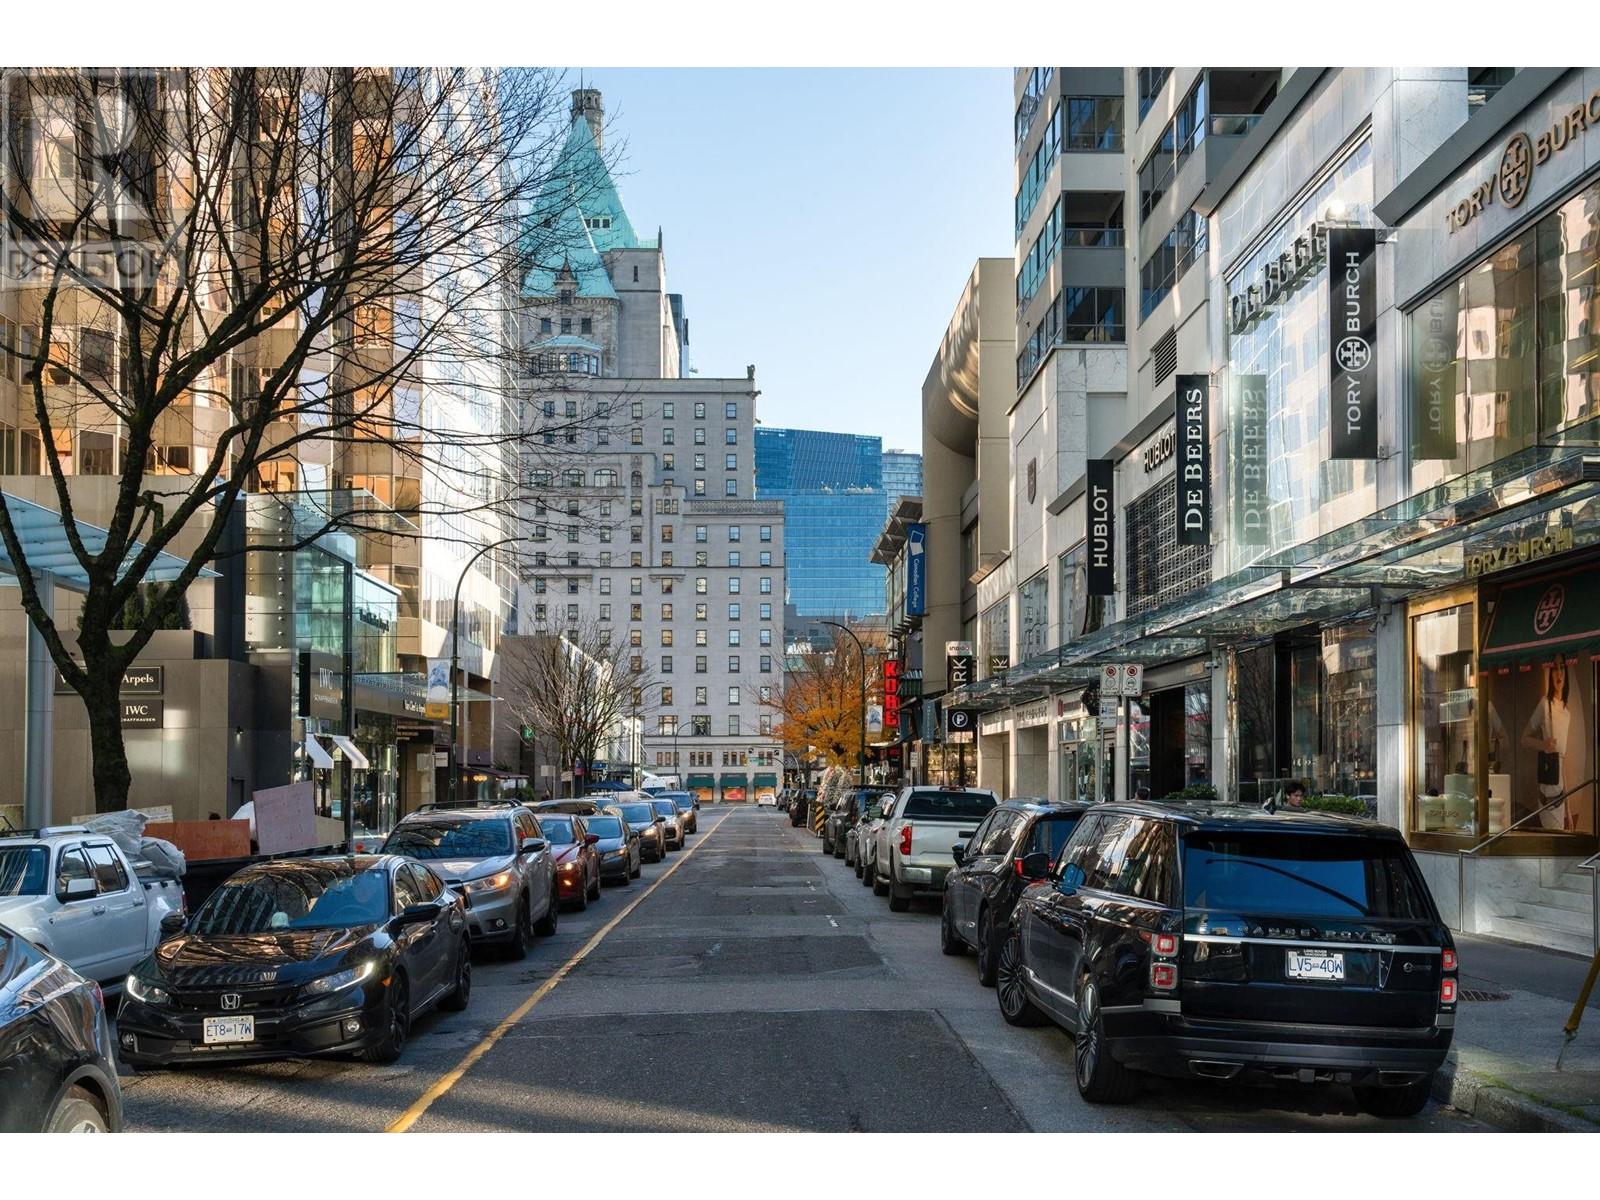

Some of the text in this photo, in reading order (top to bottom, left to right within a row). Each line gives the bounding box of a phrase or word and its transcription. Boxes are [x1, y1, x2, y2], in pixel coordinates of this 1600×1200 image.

[1446, 88, 1600, 235] TORY BURC
[1263, 222, 1327, 305] BEER
[1346, 252, 1361, 435] TORY BURCH
[1143, 430, 1176, 474] HUBLOT
[1184, 388, 1203, 532] DE BEERS
[1093, 485, 1108, 567] HUBLOT
[1465, 546, 1503, 577] TORY
[122, 673, 154, 686] Arpels
[125, 705, 148, 715] IWC
